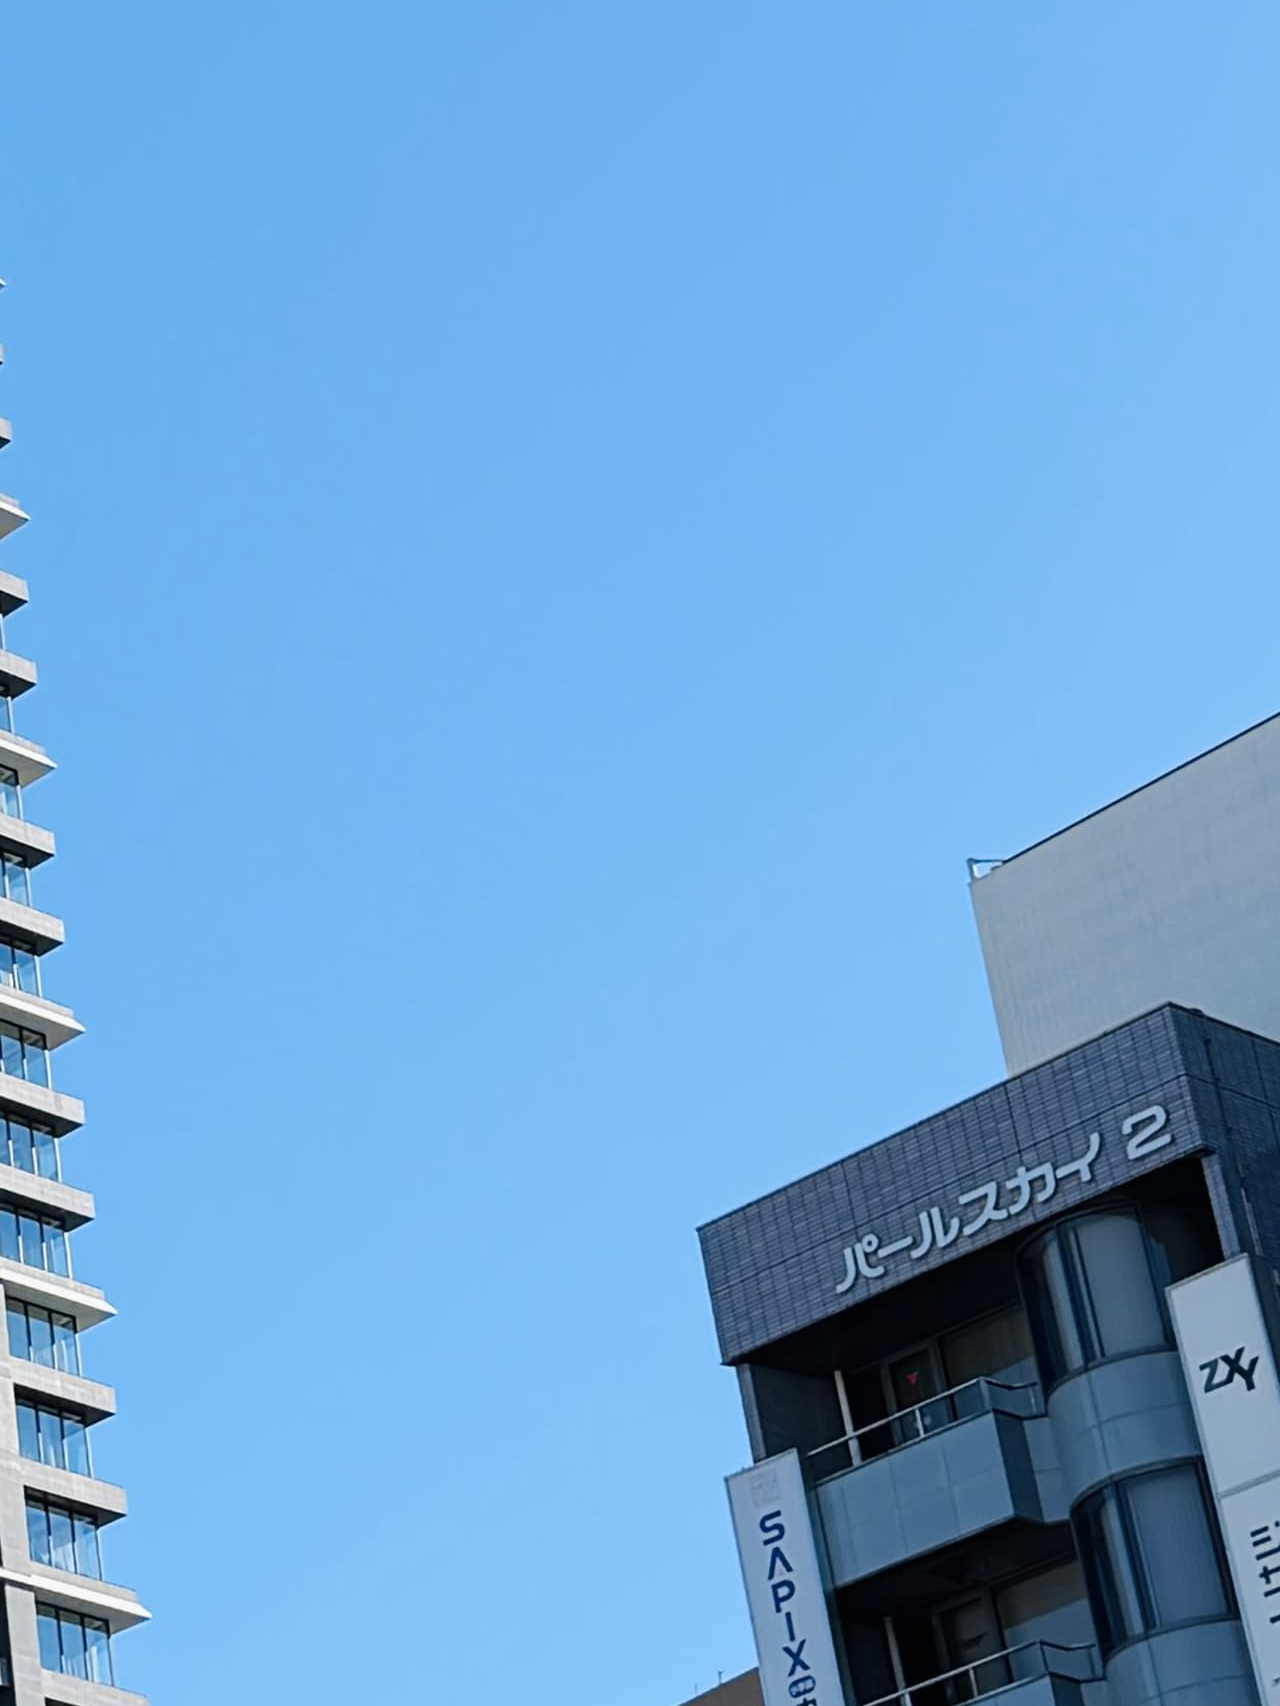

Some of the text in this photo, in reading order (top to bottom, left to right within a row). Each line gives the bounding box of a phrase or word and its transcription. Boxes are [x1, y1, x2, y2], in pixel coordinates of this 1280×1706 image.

[836, 1104, 1172, 1293] パールスカイ 2
[1199, 1346, 1259, 1393] ZXY
[759, 1510, 811, 1677] SAPIX
